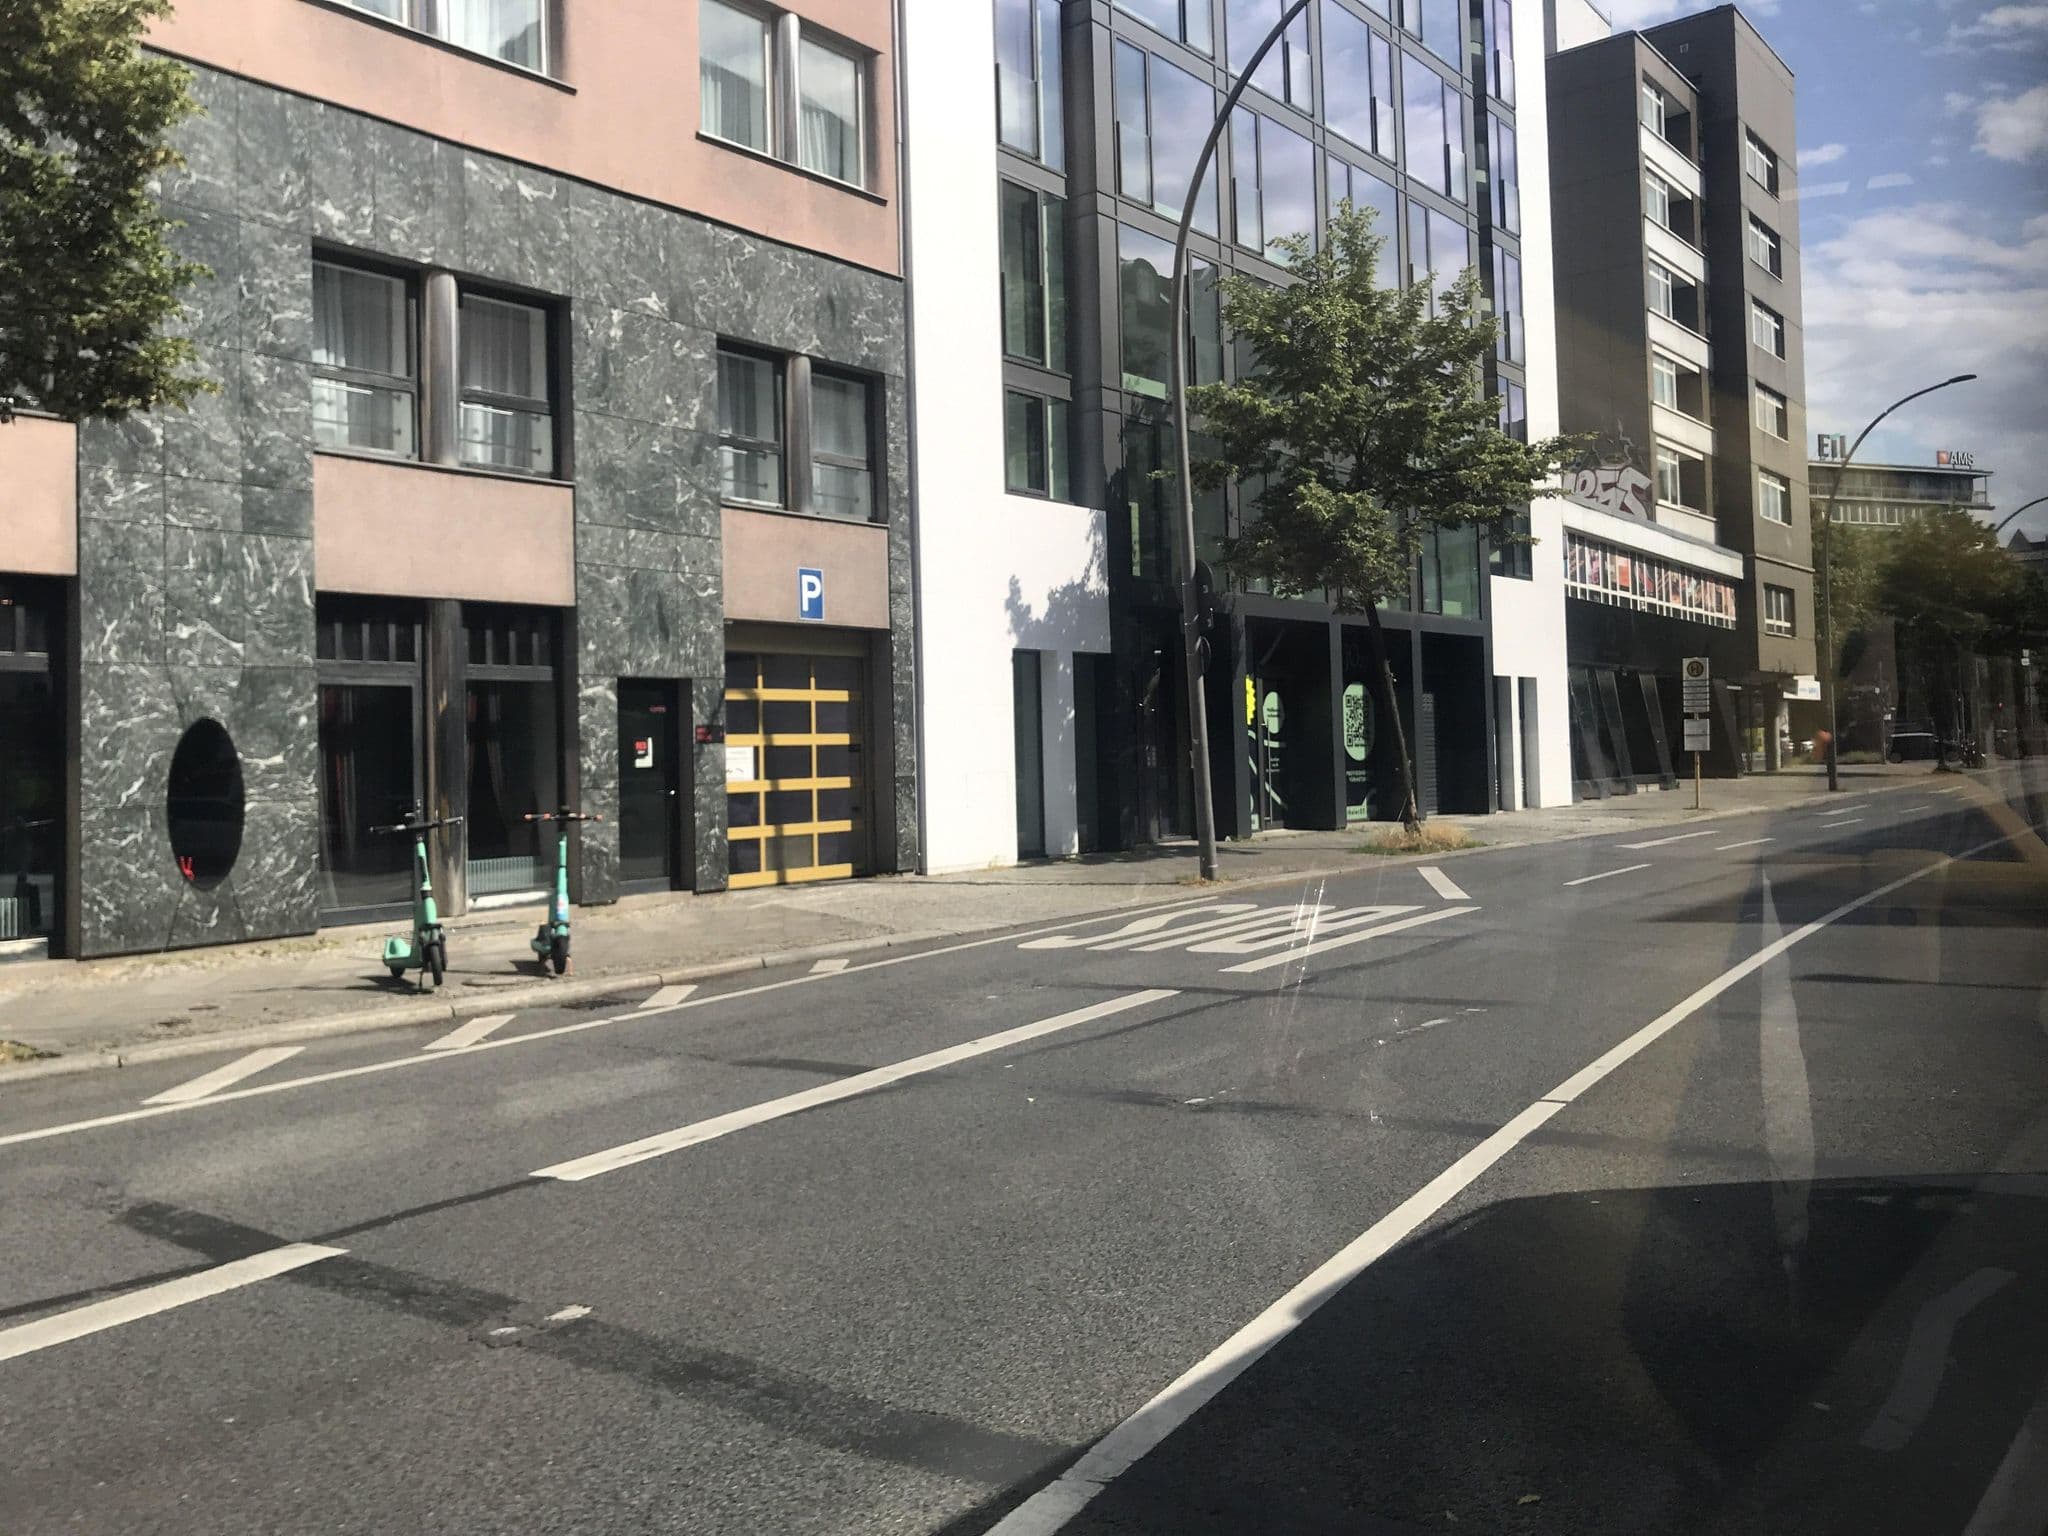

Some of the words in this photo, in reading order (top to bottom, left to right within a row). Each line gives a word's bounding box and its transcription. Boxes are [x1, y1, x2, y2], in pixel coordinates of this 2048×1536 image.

[1949, 450, 1975, 466] AMS
[801, 574, 821, 612] P
[1017, 903, 1426, 954] BUS
